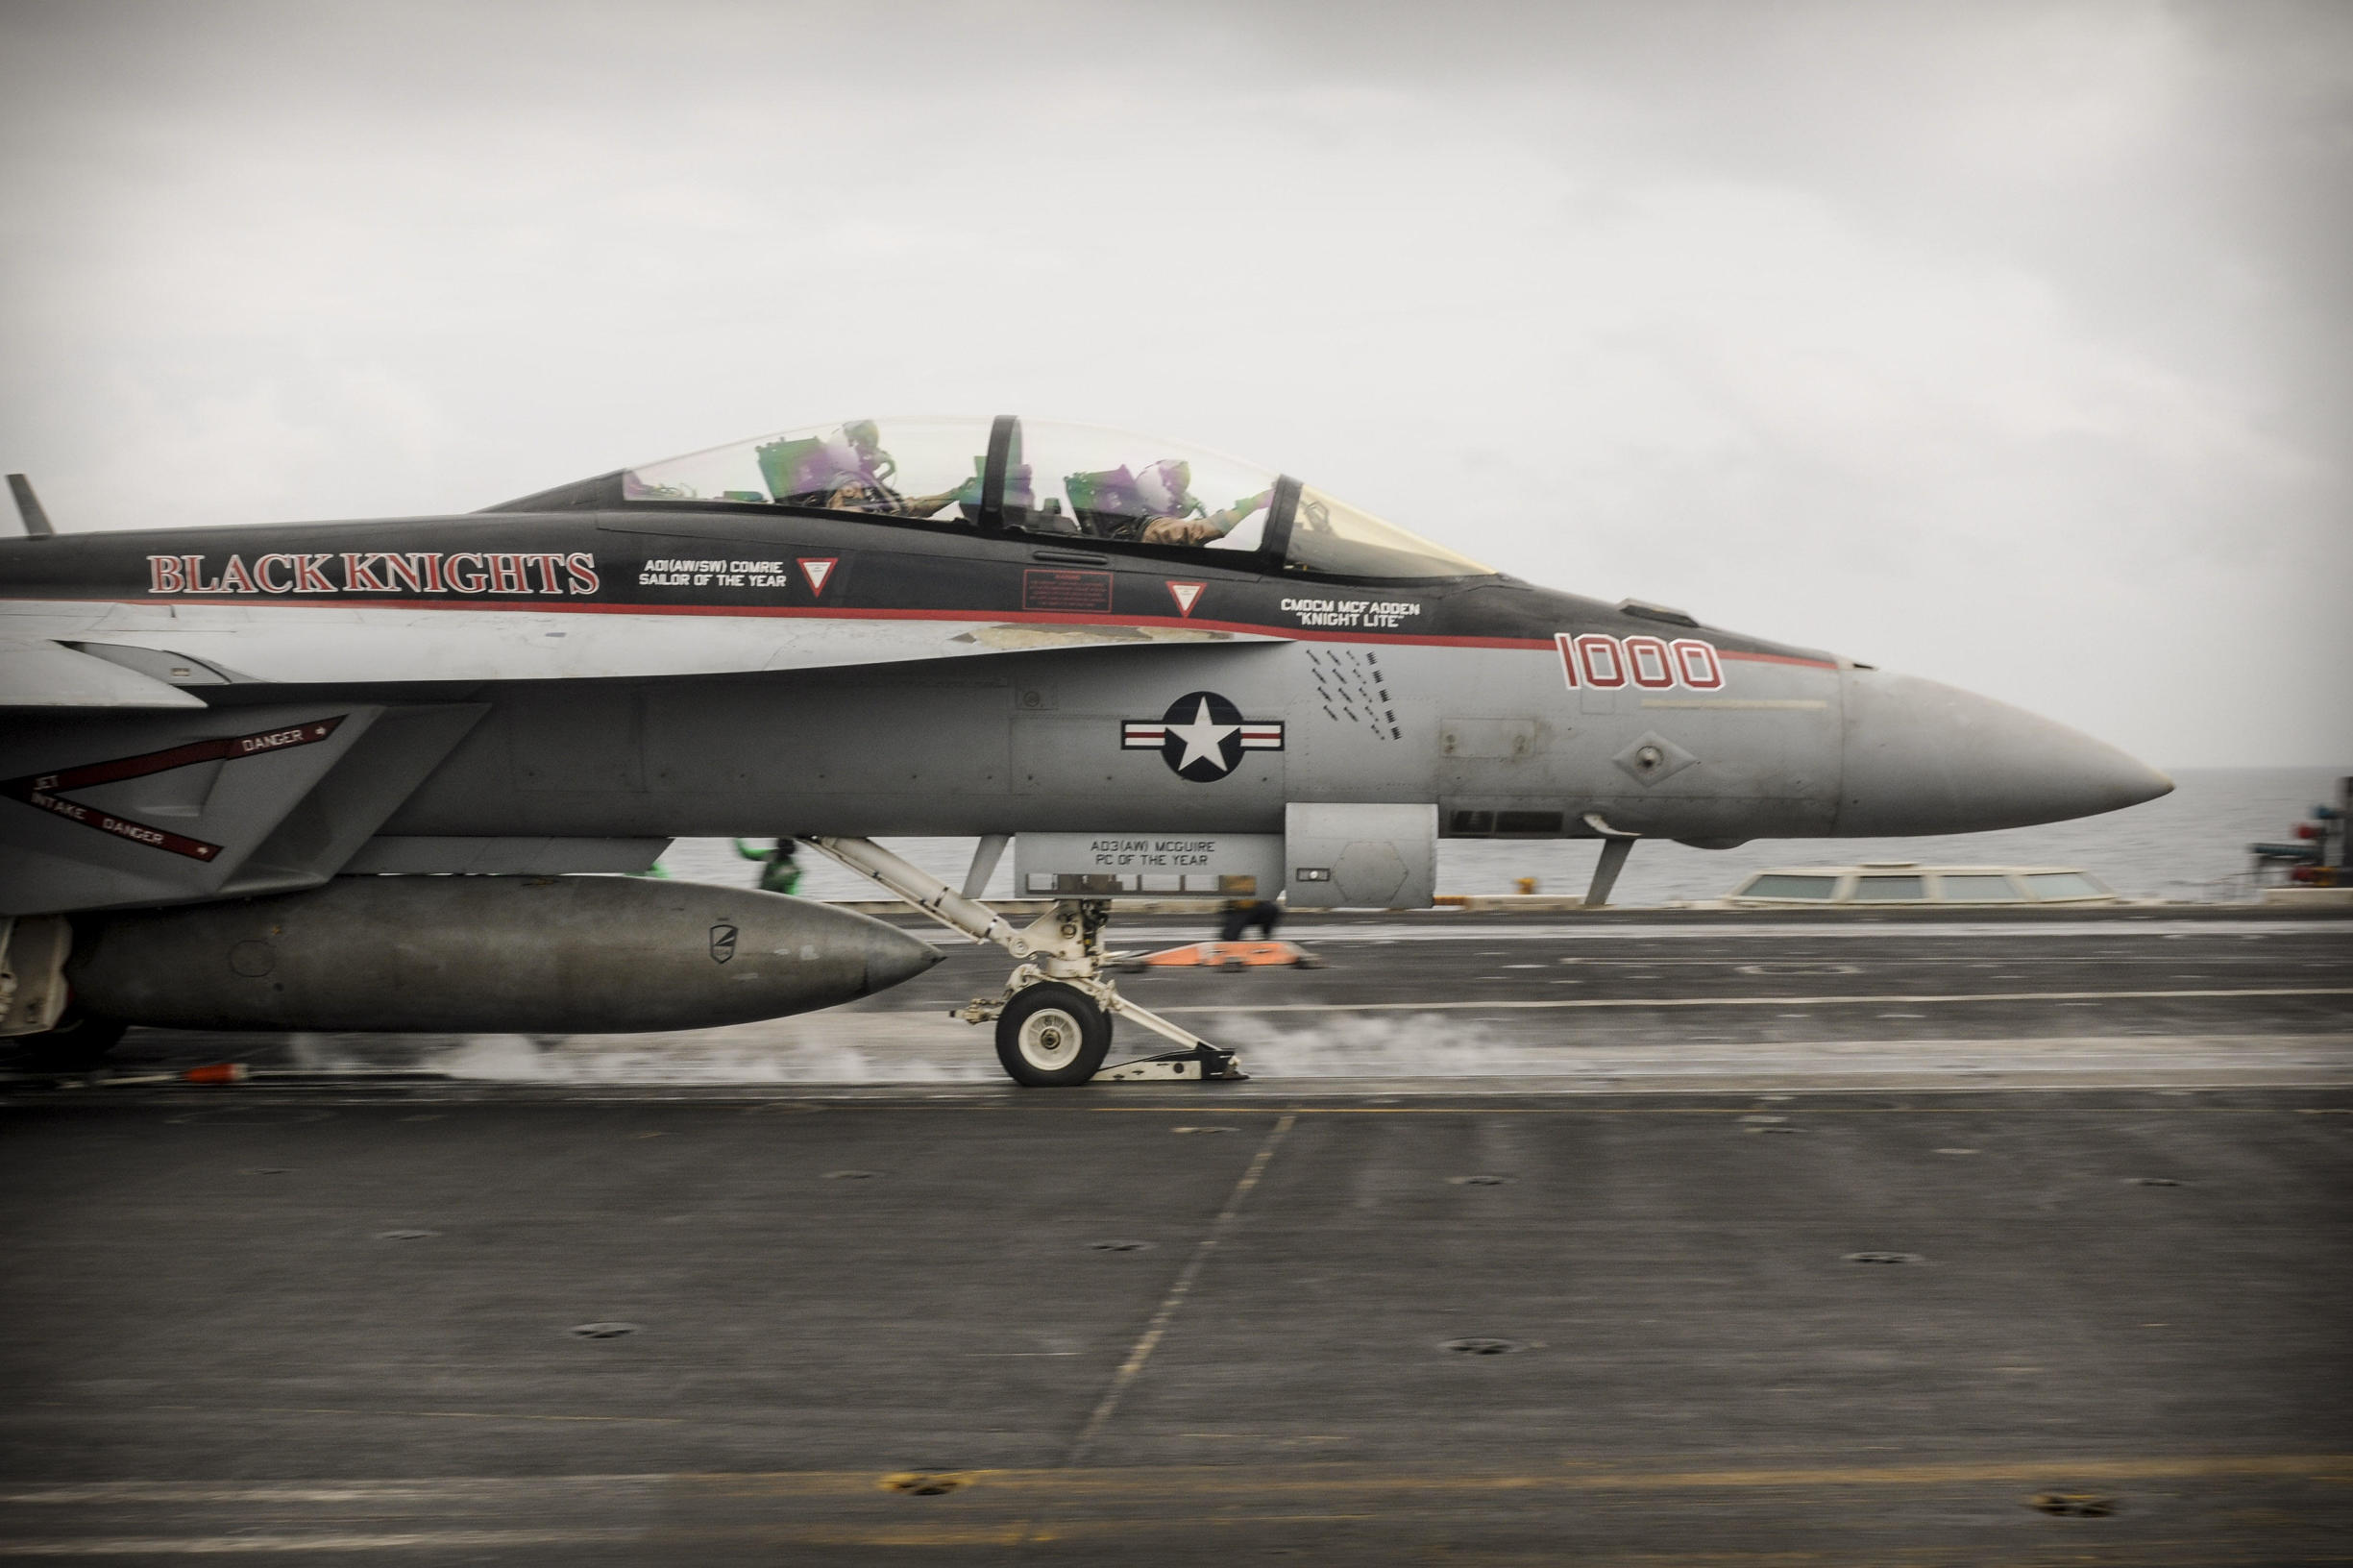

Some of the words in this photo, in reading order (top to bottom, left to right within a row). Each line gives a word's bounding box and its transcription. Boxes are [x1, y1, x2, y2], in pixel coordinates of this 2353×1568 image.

[146, 553, 338, 594] BLACK
[339, 552, 601, 595] KNIGHTS
[729, 560, 784, 574] COMRIE
[639, 574, 690, 586] SAILOR
[693, 574, 713, 586] OF
[716, 574, 745, 587] THE
[748, 575, 787, 587] YEAR
[1281, 599, 1335, 612] CMDCM
[1554, 632, 1727, 692] 1000
[242, 729, 304, 752] DANGER
[33, 774, 60, 791] JET
[30, 791, 87, 821] INTAKE
[102, 818, 165, 845] DANGER
[1155, 841, 1215, 852] MCGUIRE
[1095, 854, 1114, 865] PC
[1117, 854, 1136, 865] OF
[1140, 854, 1166, 865] THE
[1171, 854, 1209, 866] YEAR
